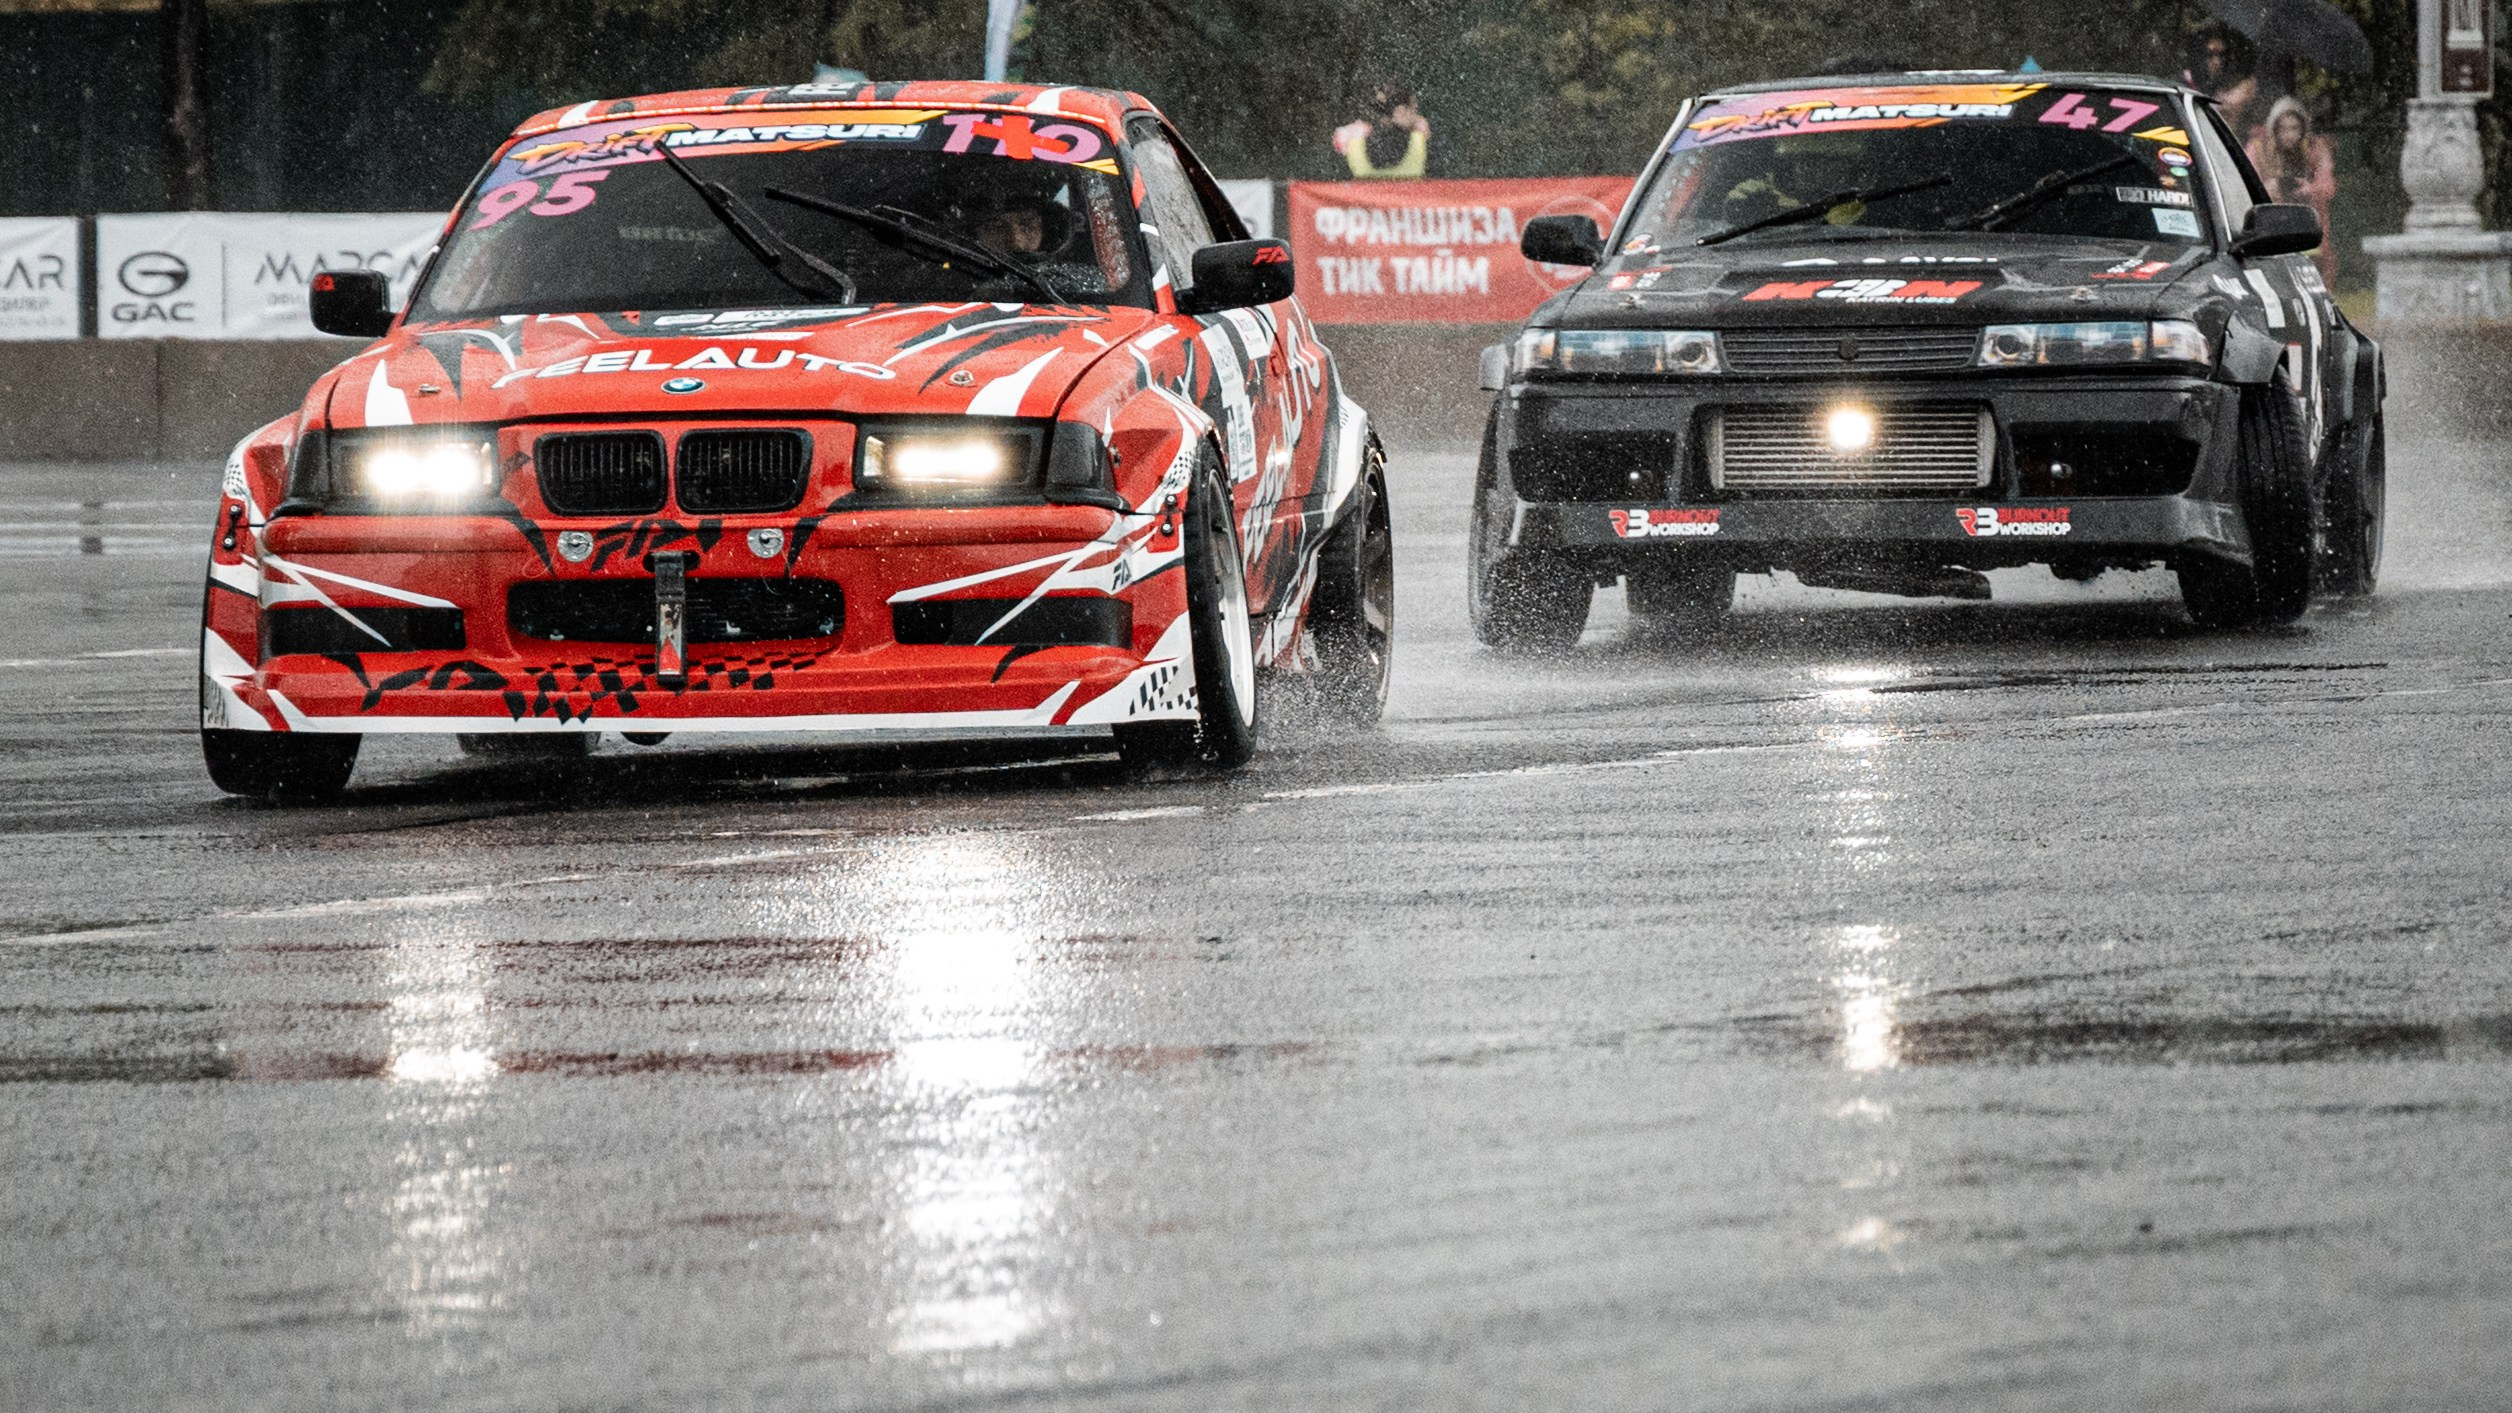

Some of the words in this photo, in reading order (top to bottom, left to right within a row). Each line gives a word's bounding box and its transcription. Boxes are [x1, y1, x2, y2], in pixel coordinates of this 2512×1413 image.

[1809, 104, 2013, 122] MATSURI
[2038, 93, 2160, 132] 47
[665, 123, 921, 148] MATSURI
[469, 170, 611, 231] 95
[1315, 206, 1519, 245] ФРАНШИЗА
[1317, 256, 1385, 295] ТИК
[1390, 249, 1490, 295] ТАЙМ
[111, 302, 196, 323] GAC
[491, 346, 898, 389] FEELAUTO
[1998, 507, 2070, 523] BURNOUT
[1649, 522, 1720, 536] WORKSHOP
[2000, 522, 2071, 536] WORKSHOP
